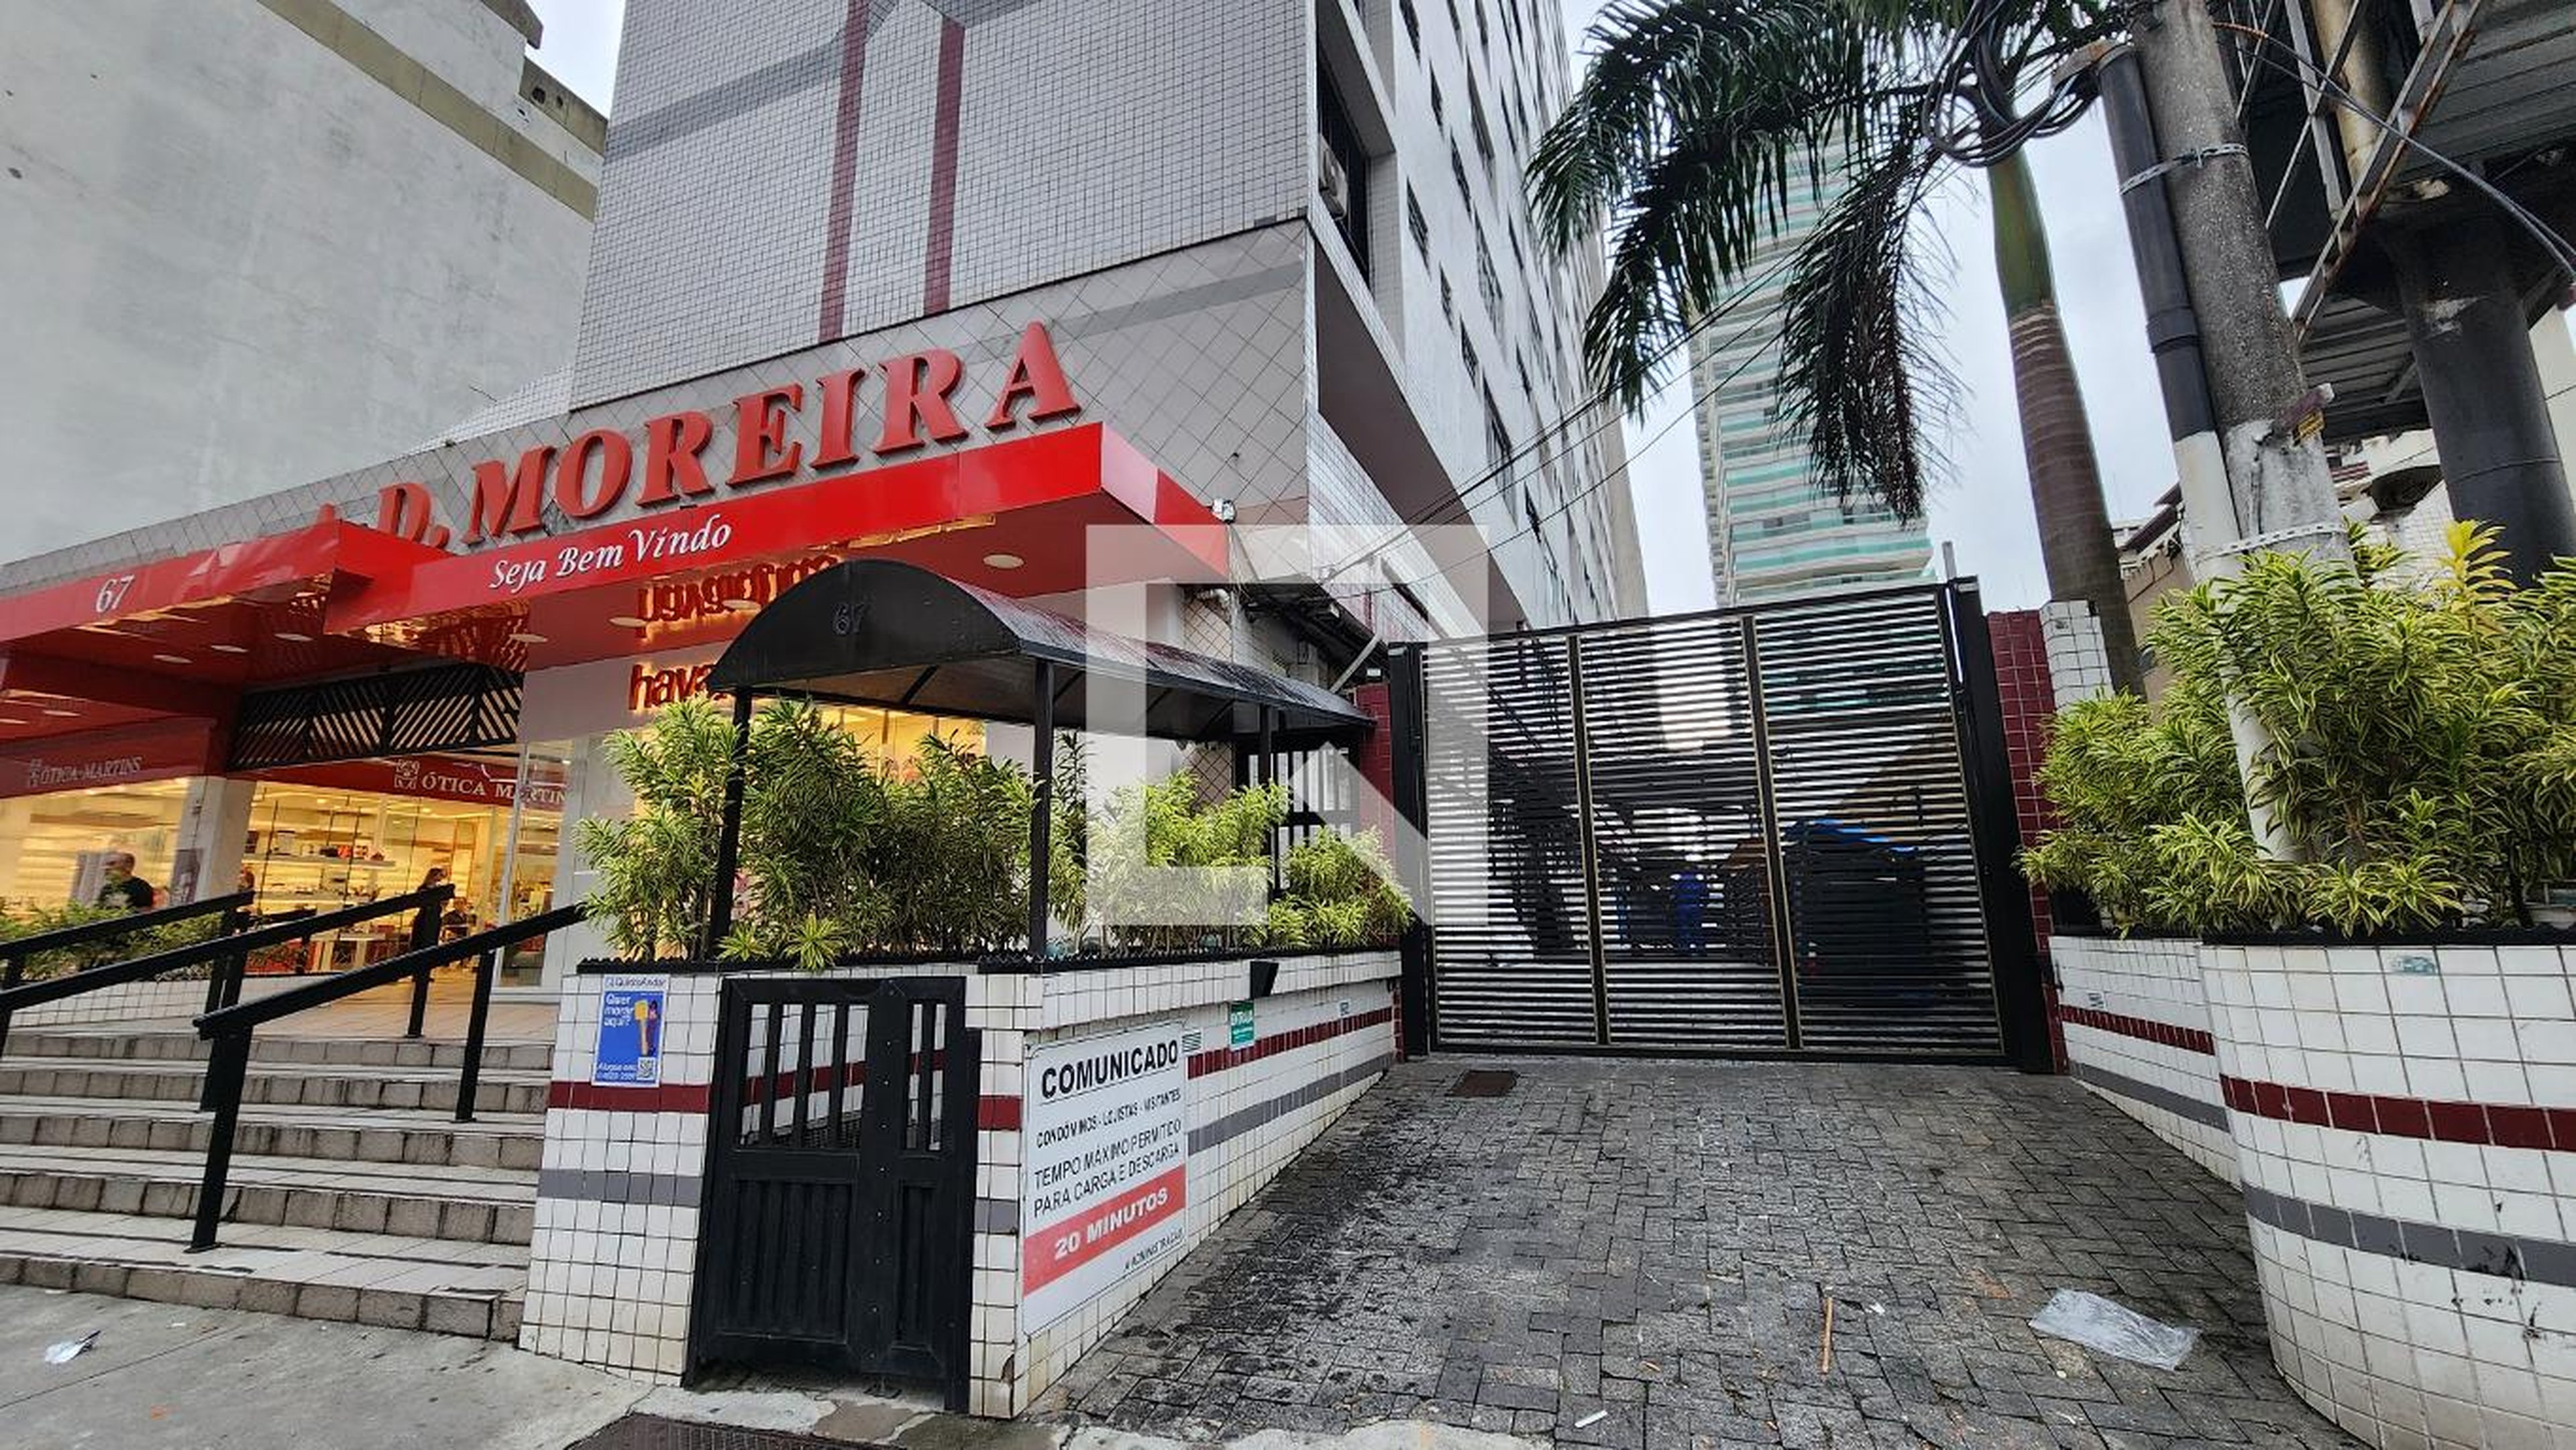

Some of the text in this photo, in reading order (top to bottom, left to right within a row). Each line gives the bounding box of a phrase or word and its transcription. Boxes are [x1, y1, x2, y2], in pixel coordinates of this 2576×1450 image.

[462, 321, 1081, 545] MOREIRA
[489, 514, 732, 595] Seja Bem Vindo
[96, 574, 135, 613] 67
[421, 771, 487, 797] ÓTICA
[1041, 1040, 1179, 1099] COMUNICADO
[1034, 1156, 1081, 1190] TEMPO
[1132, 1118, 1182, 1152] PERMITIDO
[1034, 1188, 1071, 1219] PARA
[1073, 1171, 1118, 1202] CARGA
[1128, 1141, 1180, 1178] DESCARGA
[1054, 1186, 1169, 1261] 20 MINUTOS
